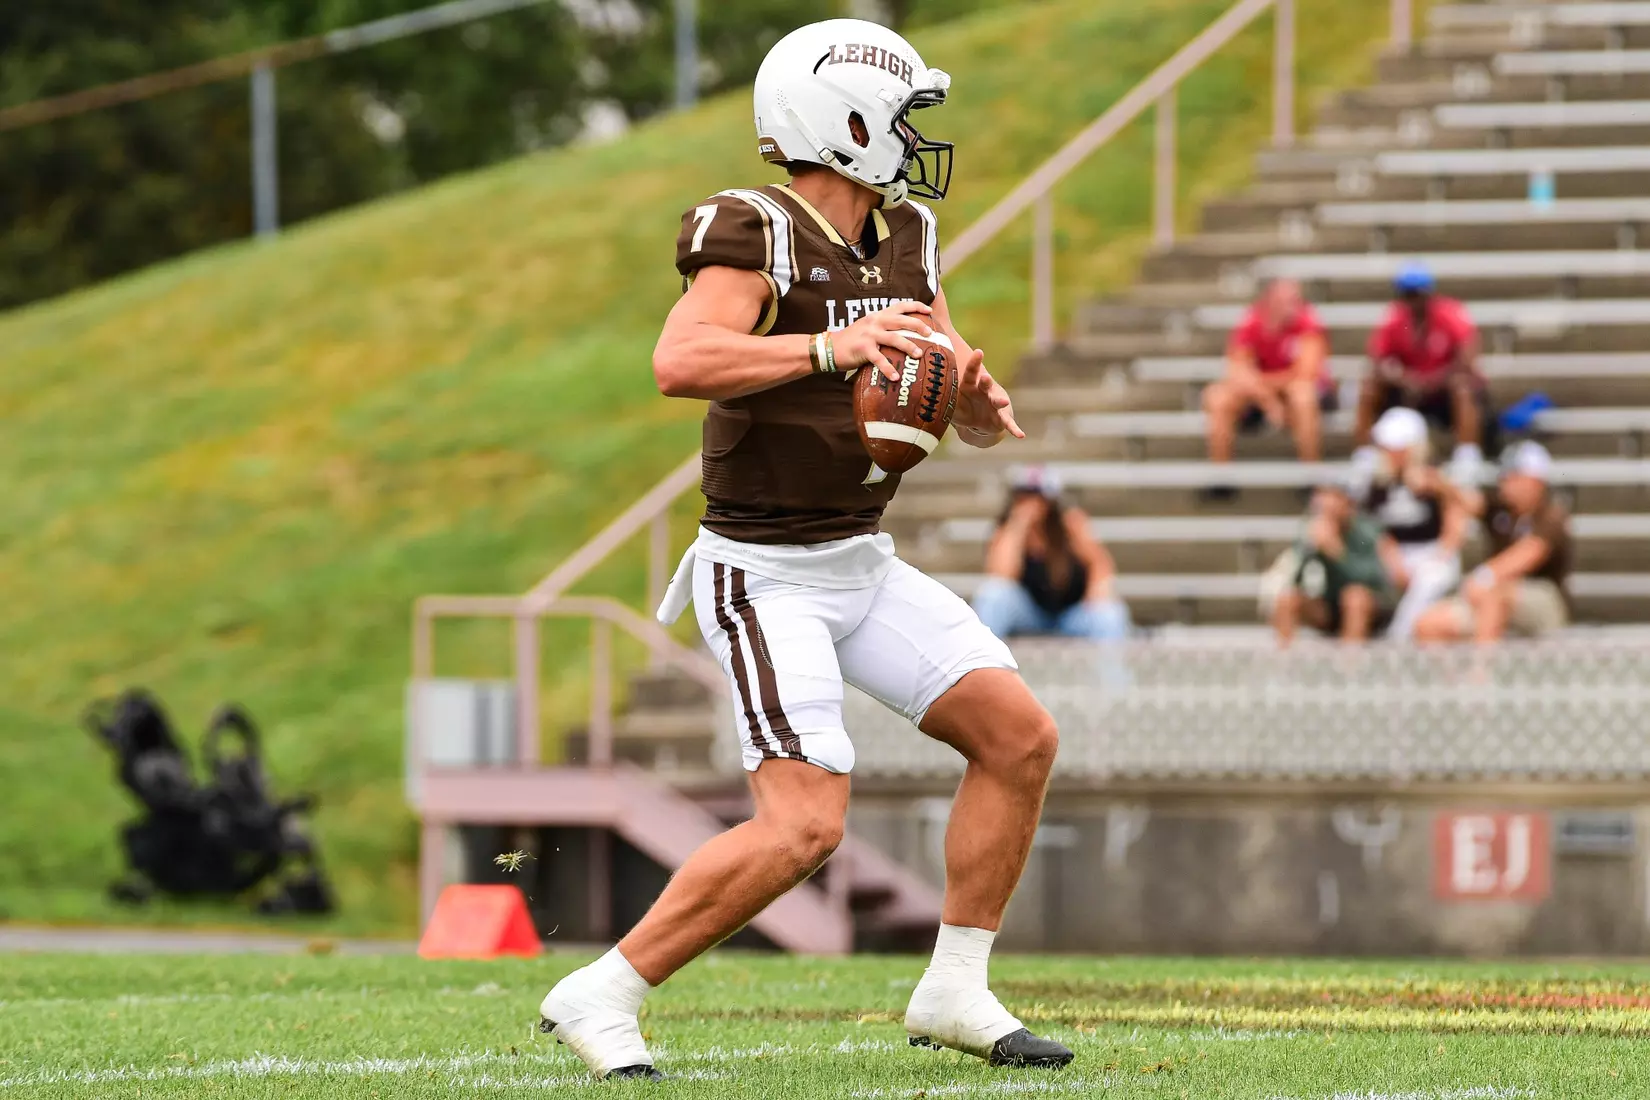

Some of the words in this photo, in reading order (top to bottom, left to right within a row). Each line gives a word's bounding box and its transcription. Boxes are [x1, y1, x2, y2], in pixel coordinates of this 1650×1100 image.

[828, 43, 914, 88] LEHIGH
[690, 205, 719, 253] 7
[897, 355, 920, 406] Wilson
[1452, 815, 1531, 893] EJ
